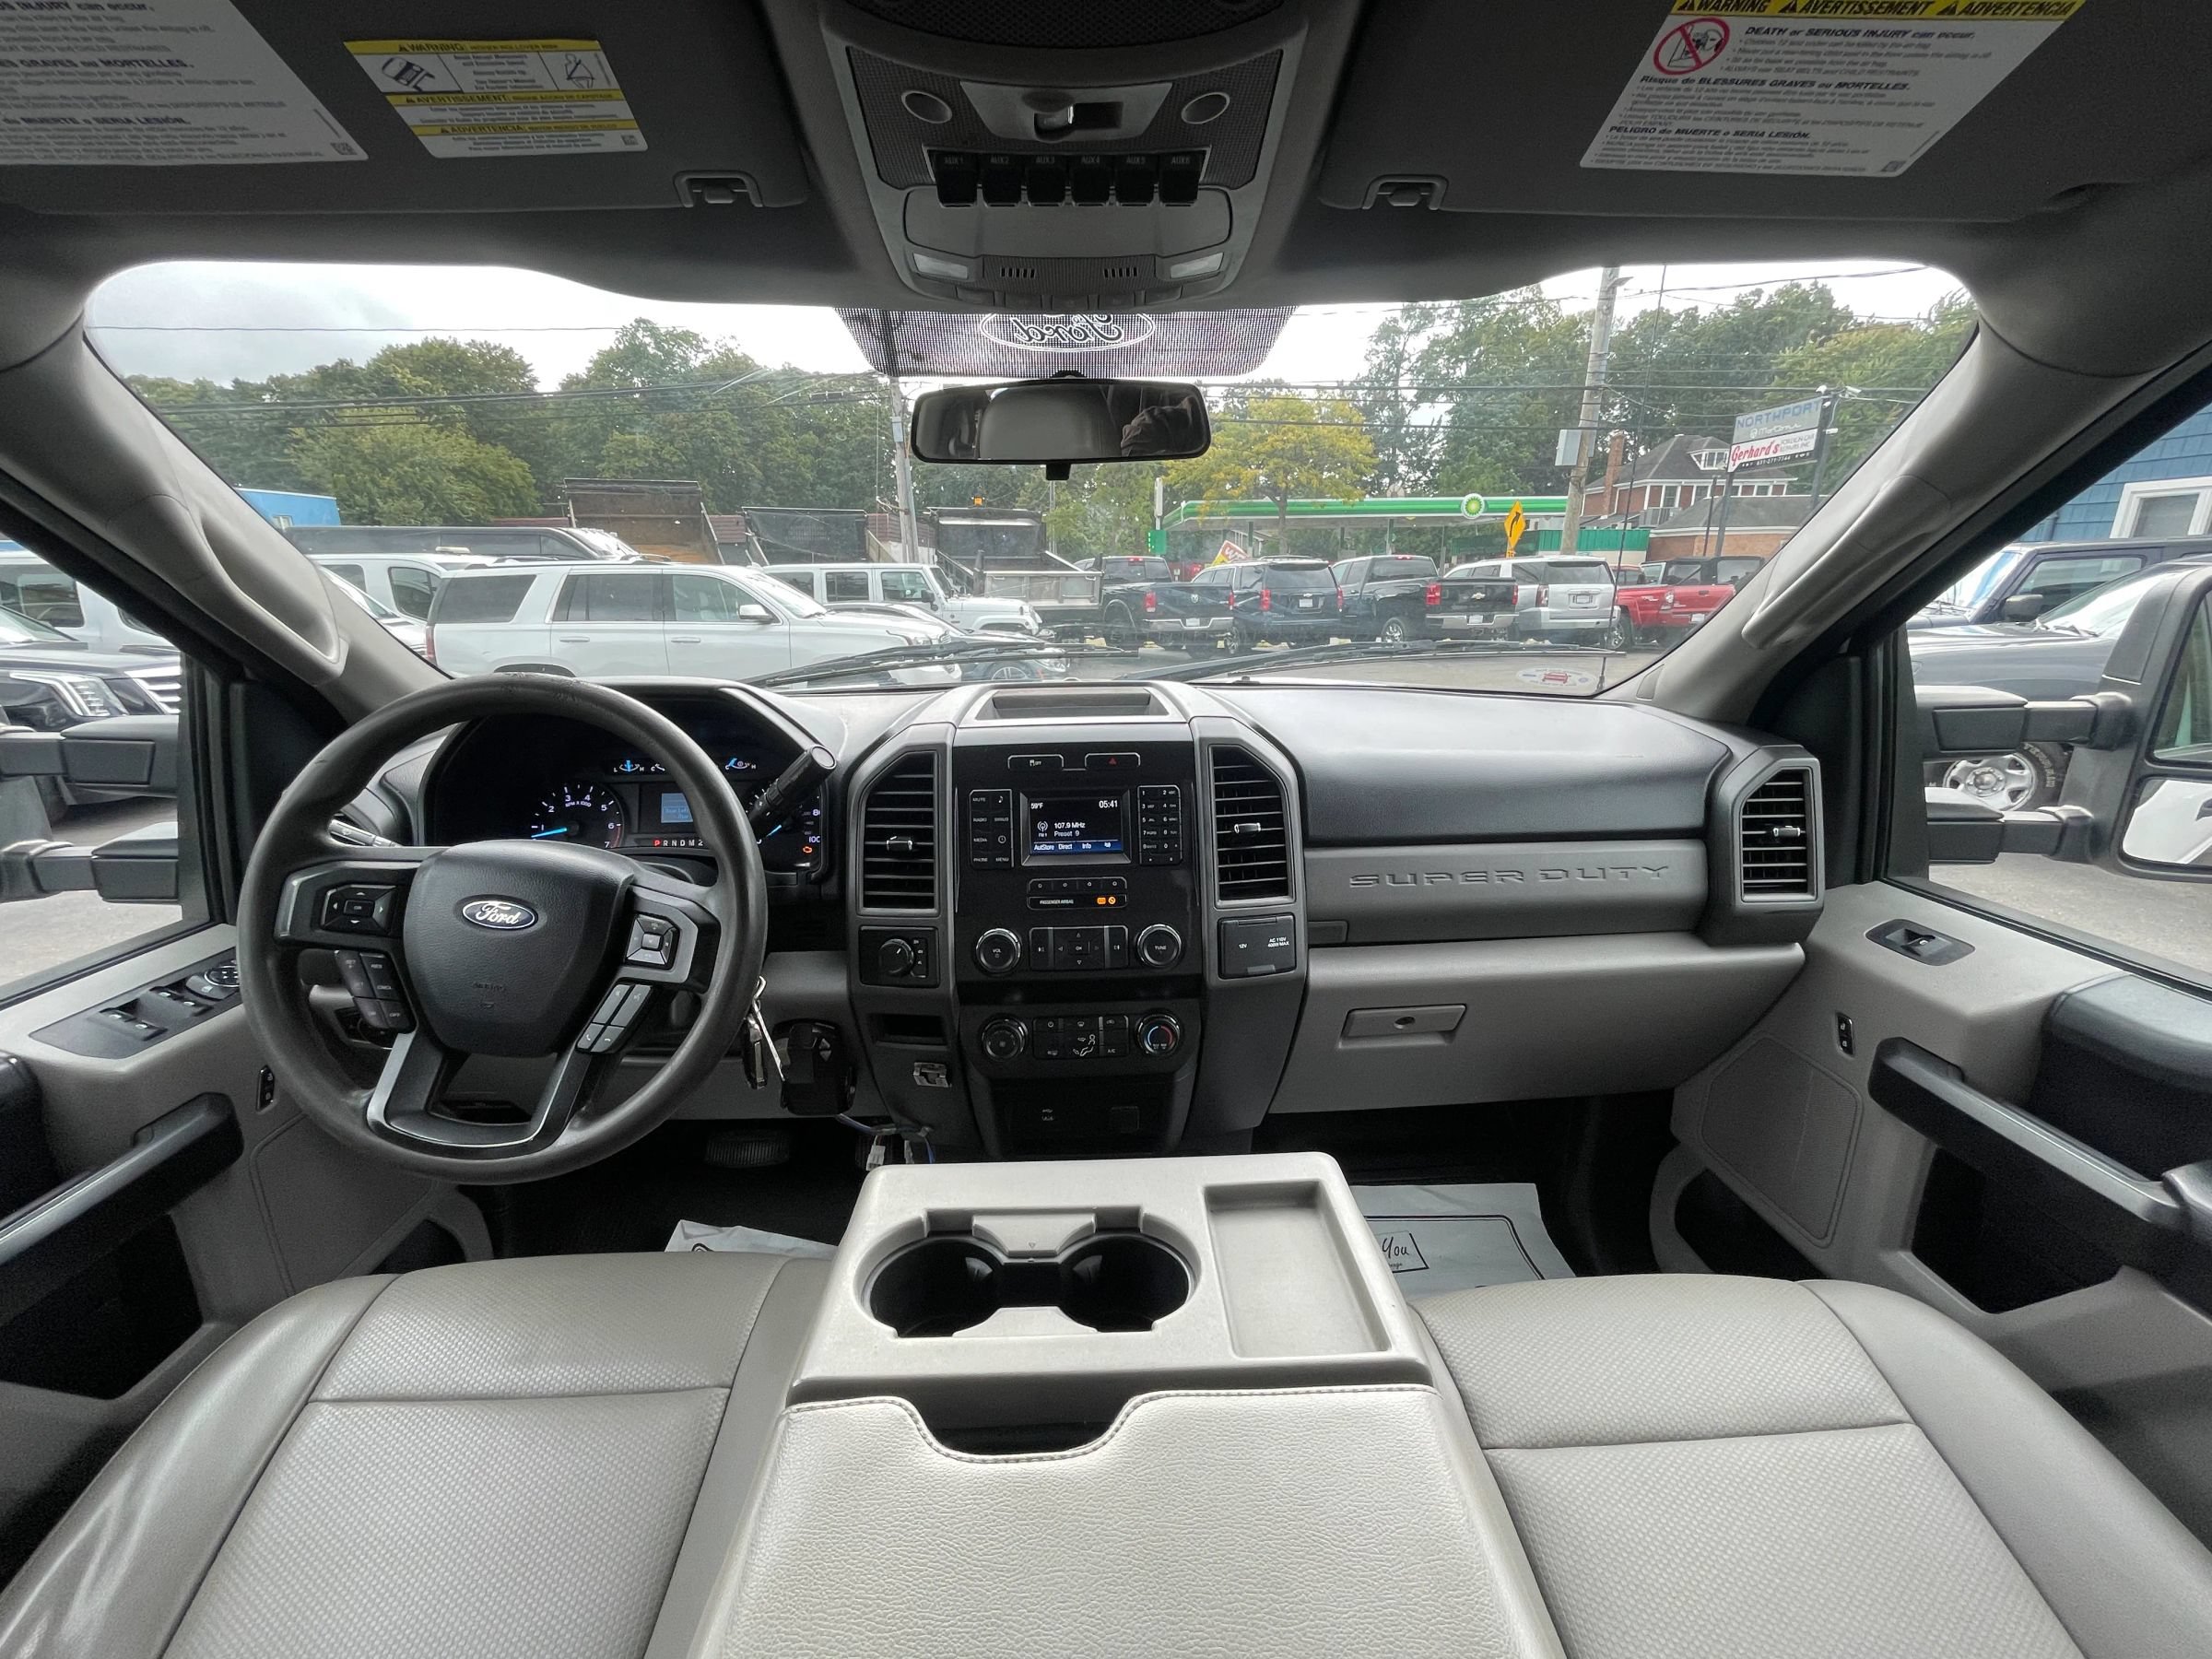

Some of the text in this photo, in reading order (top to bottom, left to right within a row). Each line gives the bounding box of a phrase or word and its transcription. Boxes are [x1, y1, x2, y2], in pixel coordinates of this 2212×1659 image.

[1696, 0, 2077, 16] WARNING AVERTISSEMENT ADVERTENCIA
[1745, 26, 1788, 35] DEATH
[1805, 28, 1860, 38] SERIOUS
[1862, 29, 1912, 39] INJURY
[1640, 76, 1678, 85] Risque
[1698, 77, 1767, 88] BLESSURES
[1769, 80, 1817, 88] GRAVES
[1834, 81, 1911, 90] MORTELLES.
[1608, 125, 1656, 135] PELIGRO
[1736, 400, 1821, 429] NORTHPORT
[1732, 440, 1781, 466] Gerhard's
[584, 794, 591, 802] 4
[1099, 800, 1118, 808] 05:41
[1349, 865, 1669, 888] SUPER DUTY
[475, 900, 523, 925] Ford
[1382, 1236, 1409, 1259] You
